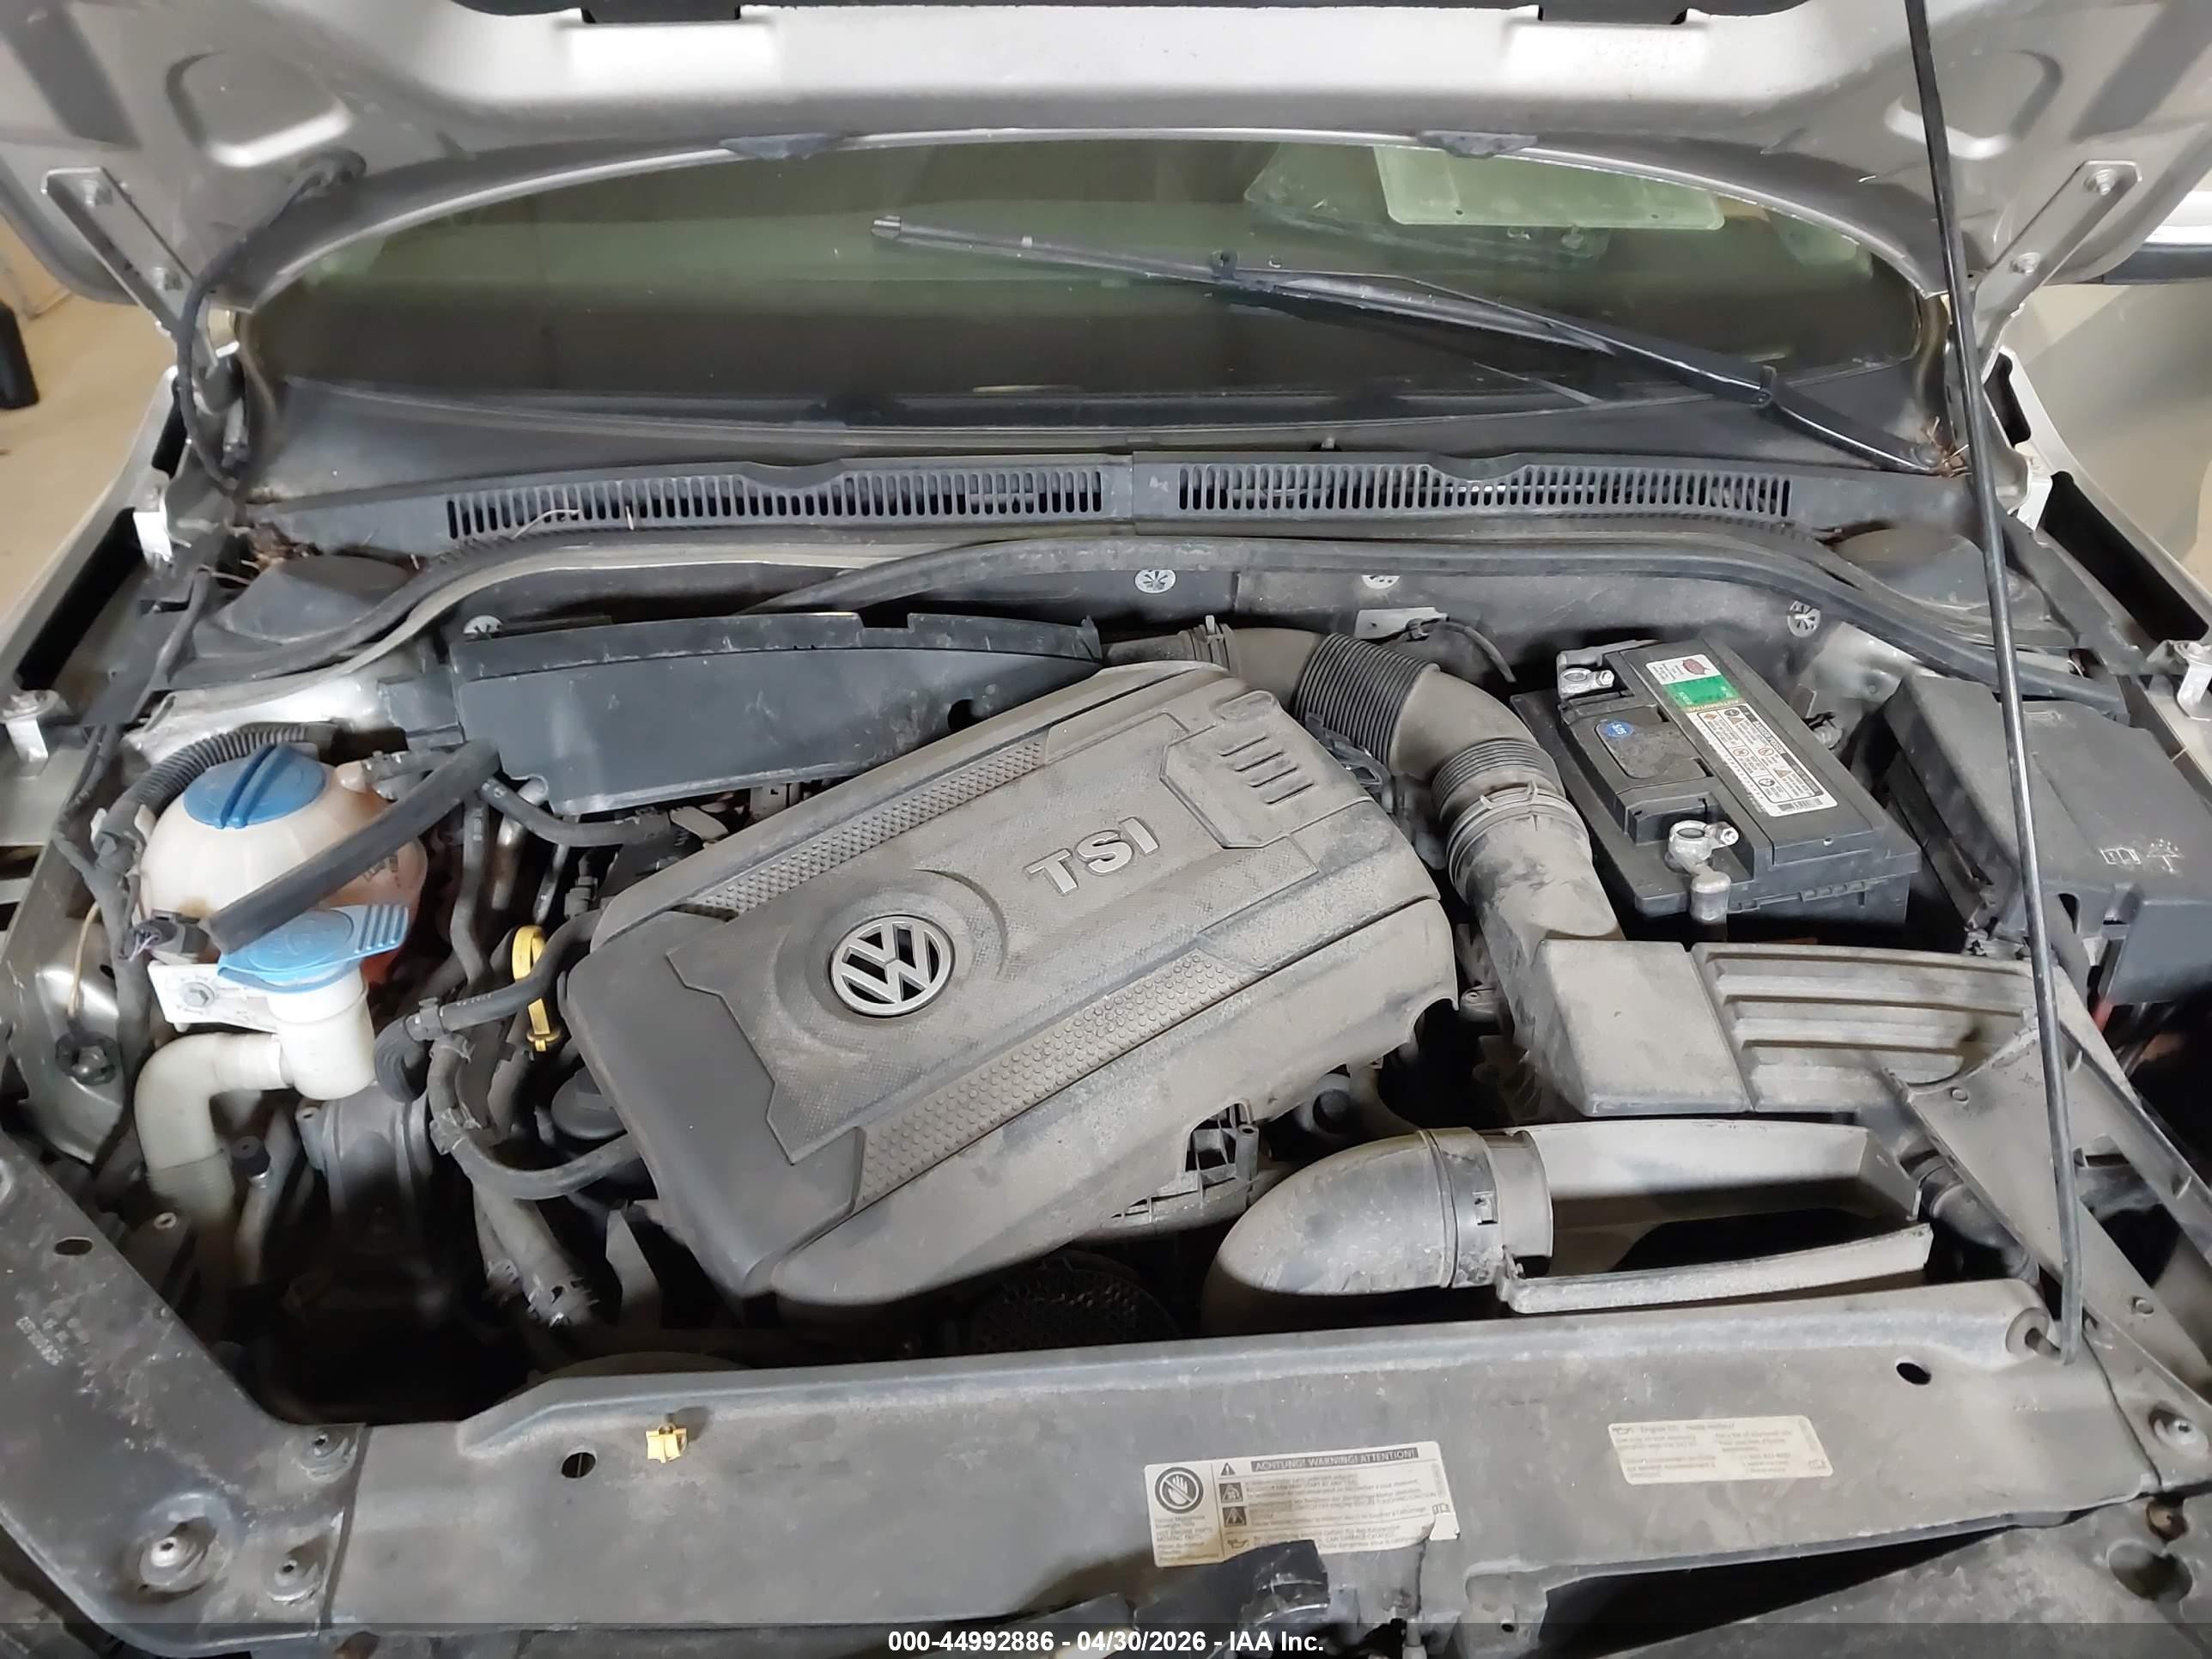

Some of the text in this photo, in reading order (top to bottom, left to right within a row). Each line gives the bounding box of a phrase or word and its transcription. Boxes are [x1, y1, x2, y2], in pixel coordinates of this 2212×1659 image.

[1024, 817, 1161, 895] TSI
[830, 915, 955, 1018] VW
[1255, 1449, 1416, 1471] ACHTUNG! WARNING! ATTENTION!
